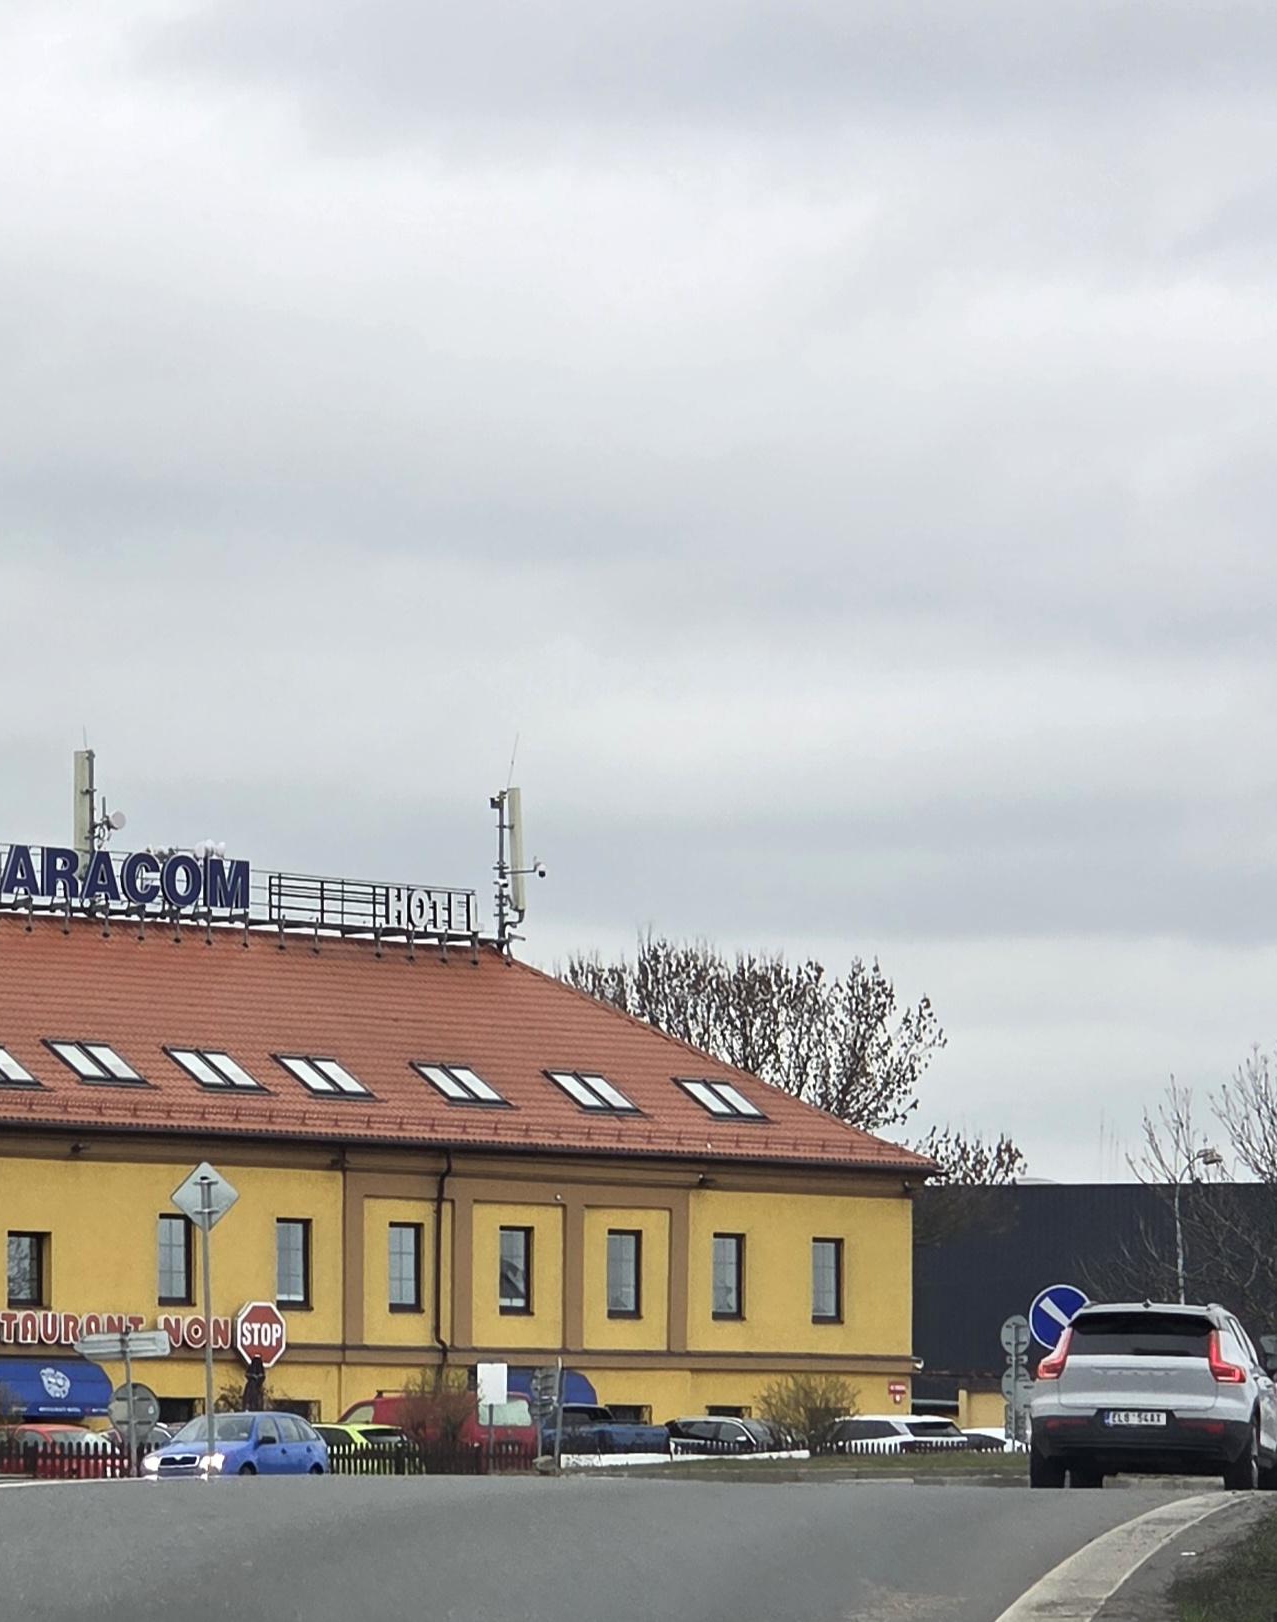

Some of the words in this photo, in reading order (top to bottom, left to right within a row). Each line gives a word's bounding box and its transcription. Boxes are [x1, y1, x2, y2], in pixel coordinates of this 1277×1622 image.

[385, 886, 483, 933] HOTEL
[157, 1314, 231, 1349] NON
[242, 1322, 282, 1347] STOP
